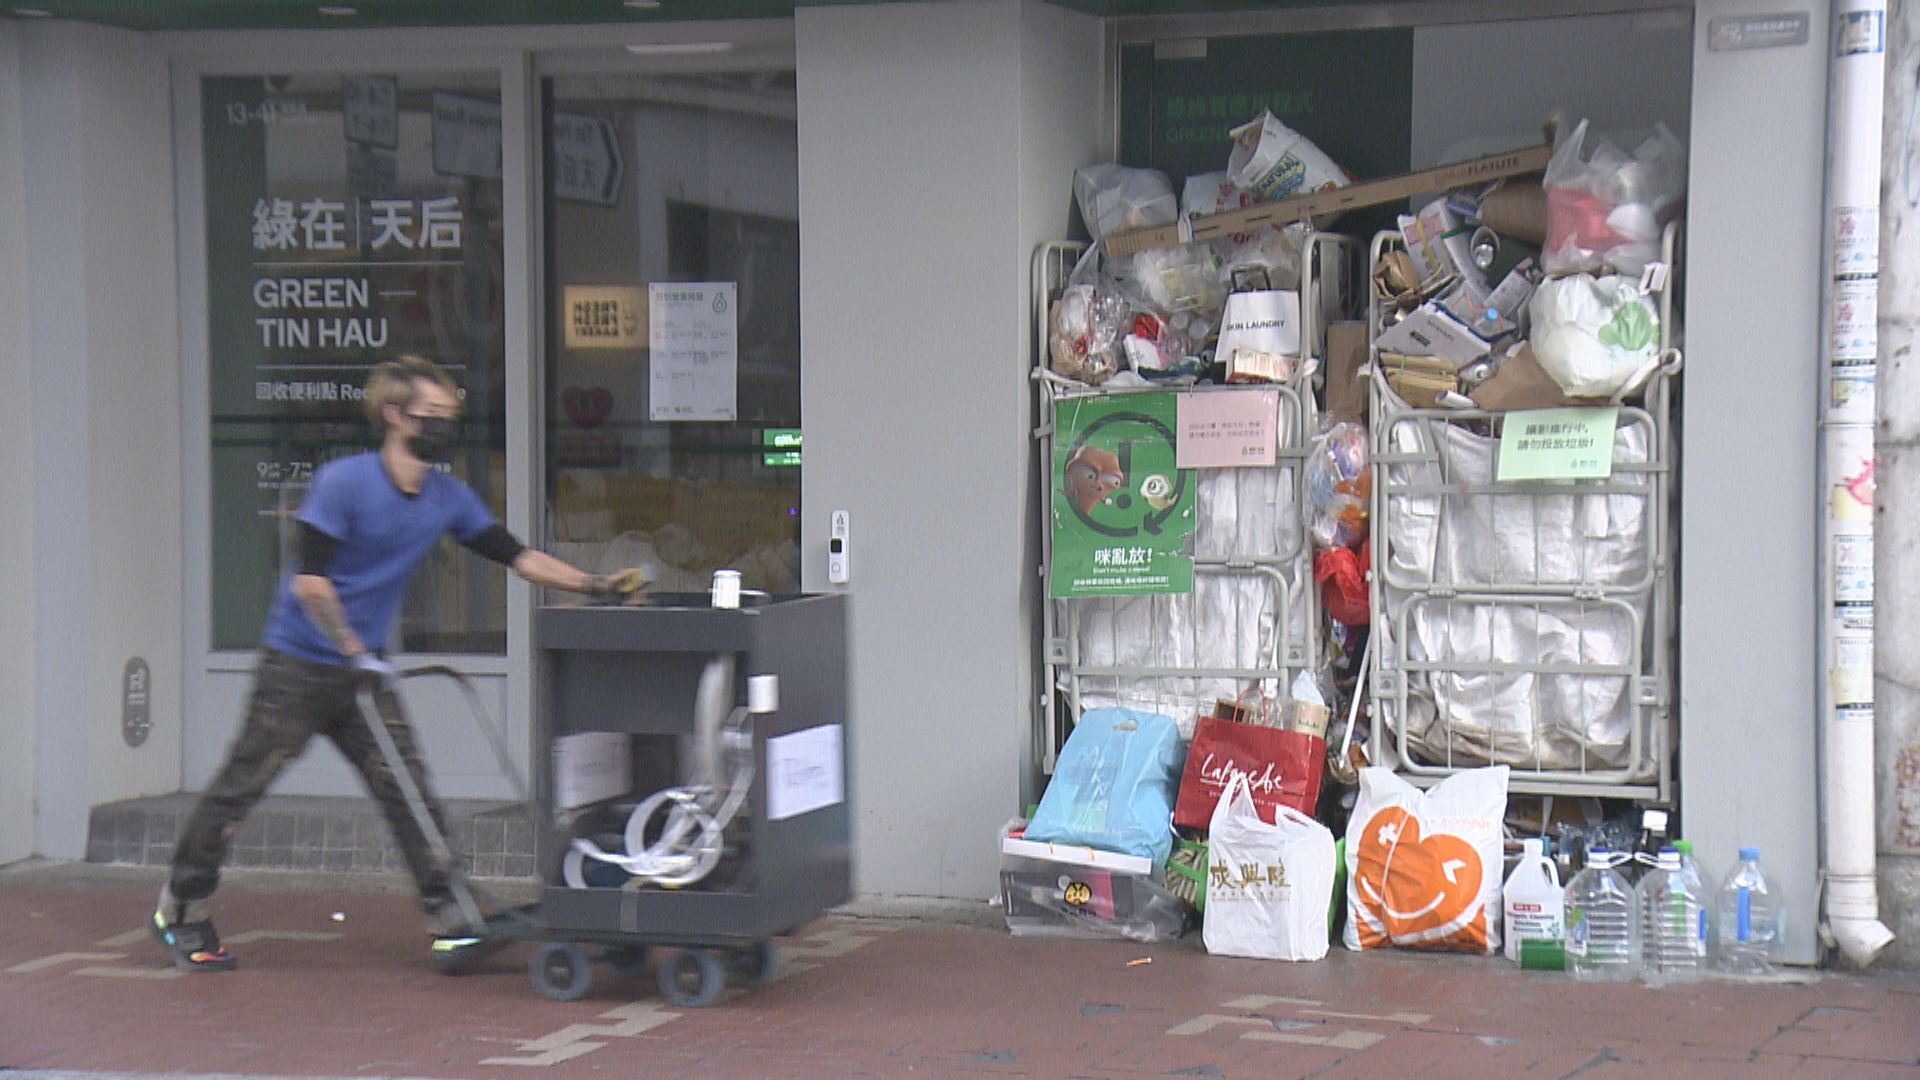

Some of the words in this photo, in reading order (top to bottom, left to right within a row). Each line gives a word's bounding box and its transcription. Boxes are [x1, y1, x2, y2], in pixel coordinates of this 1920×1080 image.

[252, 197, 346, 250] 綠在
[370, 196, 464, 250] 天后
[253, 278, 369, 308] GREEN
[255, 318, 311, 348] TIN
[317, 318, 388, 348] HAU
[1245, 319, 1285, 330] LAUNDRY
[255, 382, 336, 400] 回收便利點
[1094, 546, 1153, 566] 咪亂放!
